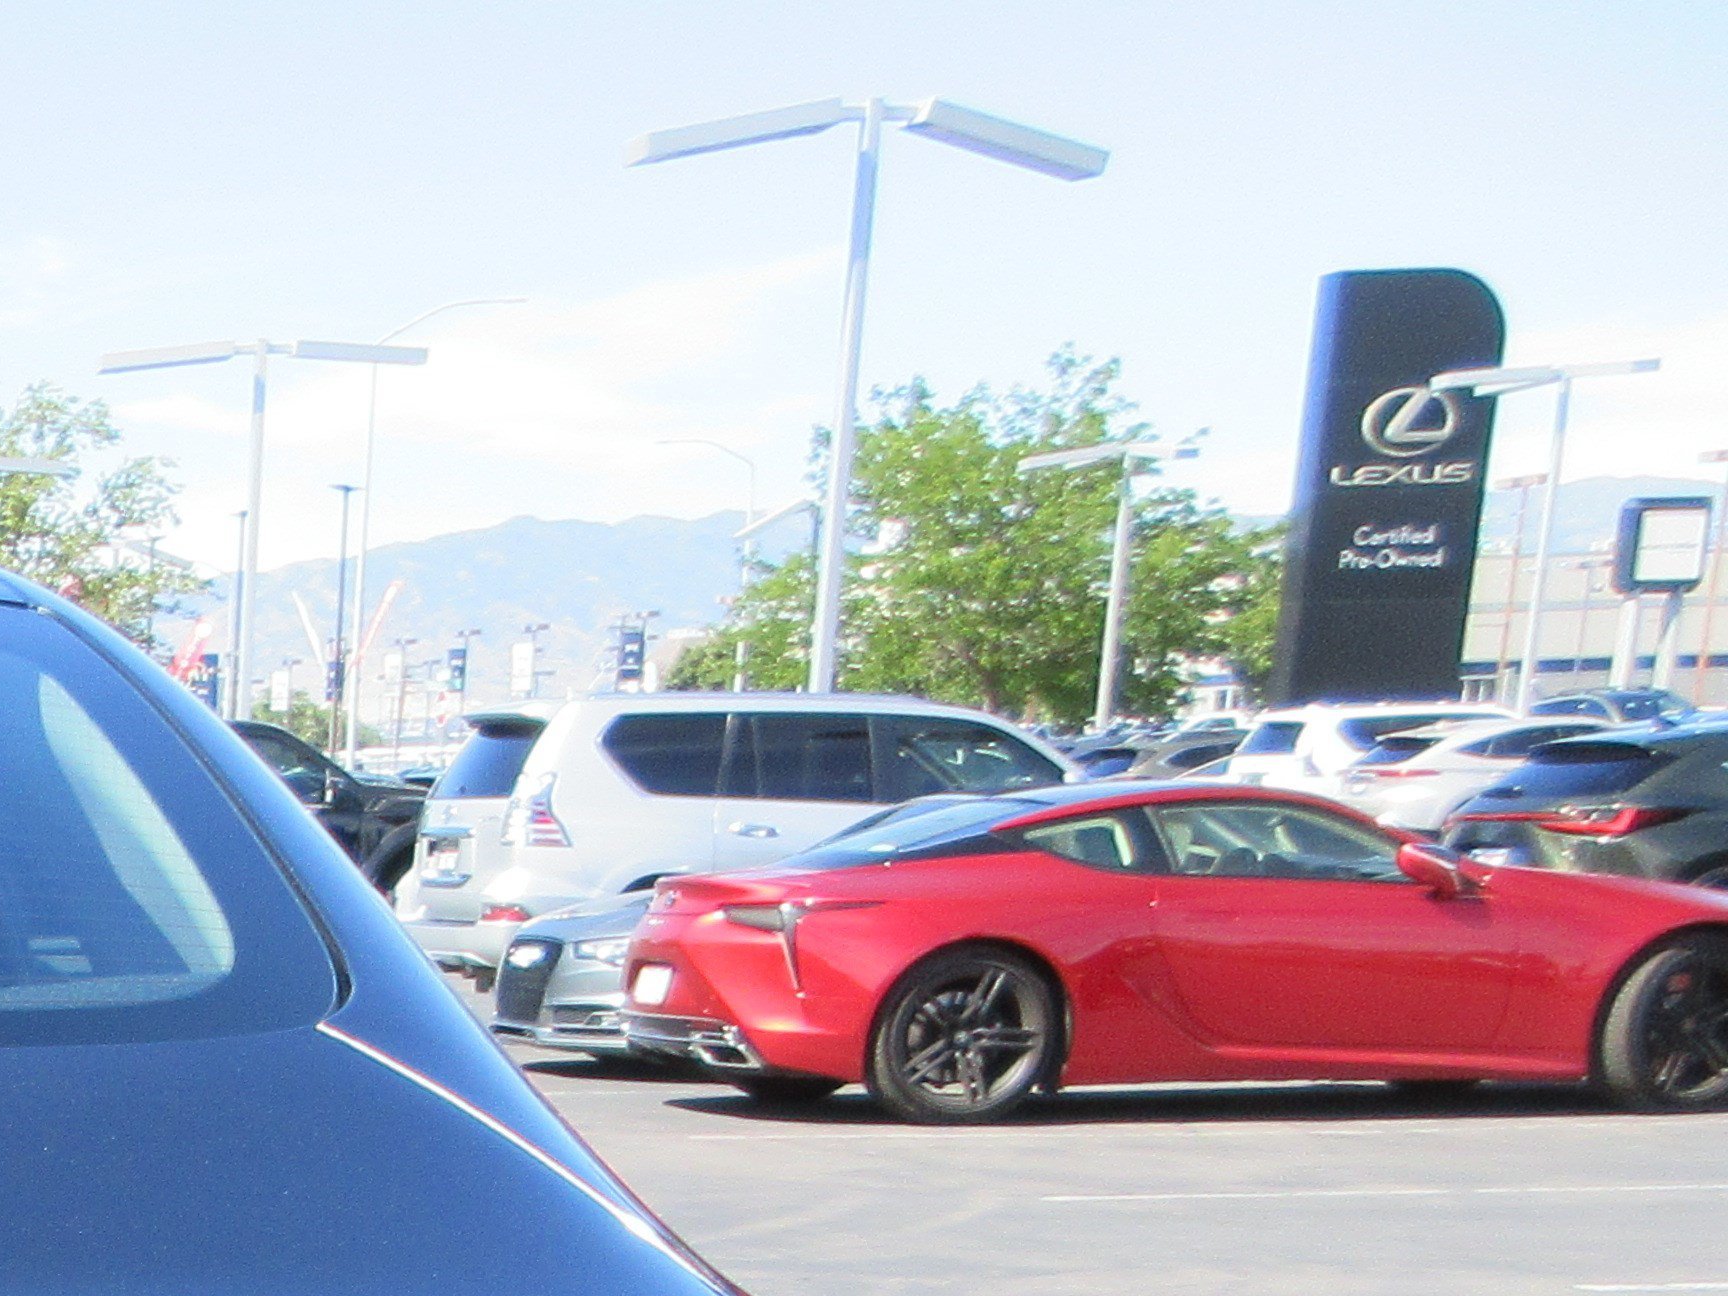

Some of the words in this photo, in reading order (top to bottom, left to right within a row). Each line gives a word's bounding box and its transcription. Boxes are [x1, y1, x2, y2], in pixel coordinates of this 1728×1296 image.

[1330, 461, 1475, 486] LEXUS
[1352, 523, 1438, 546] Certified
[1337, 546, 1446, 569] Pre-Owned
